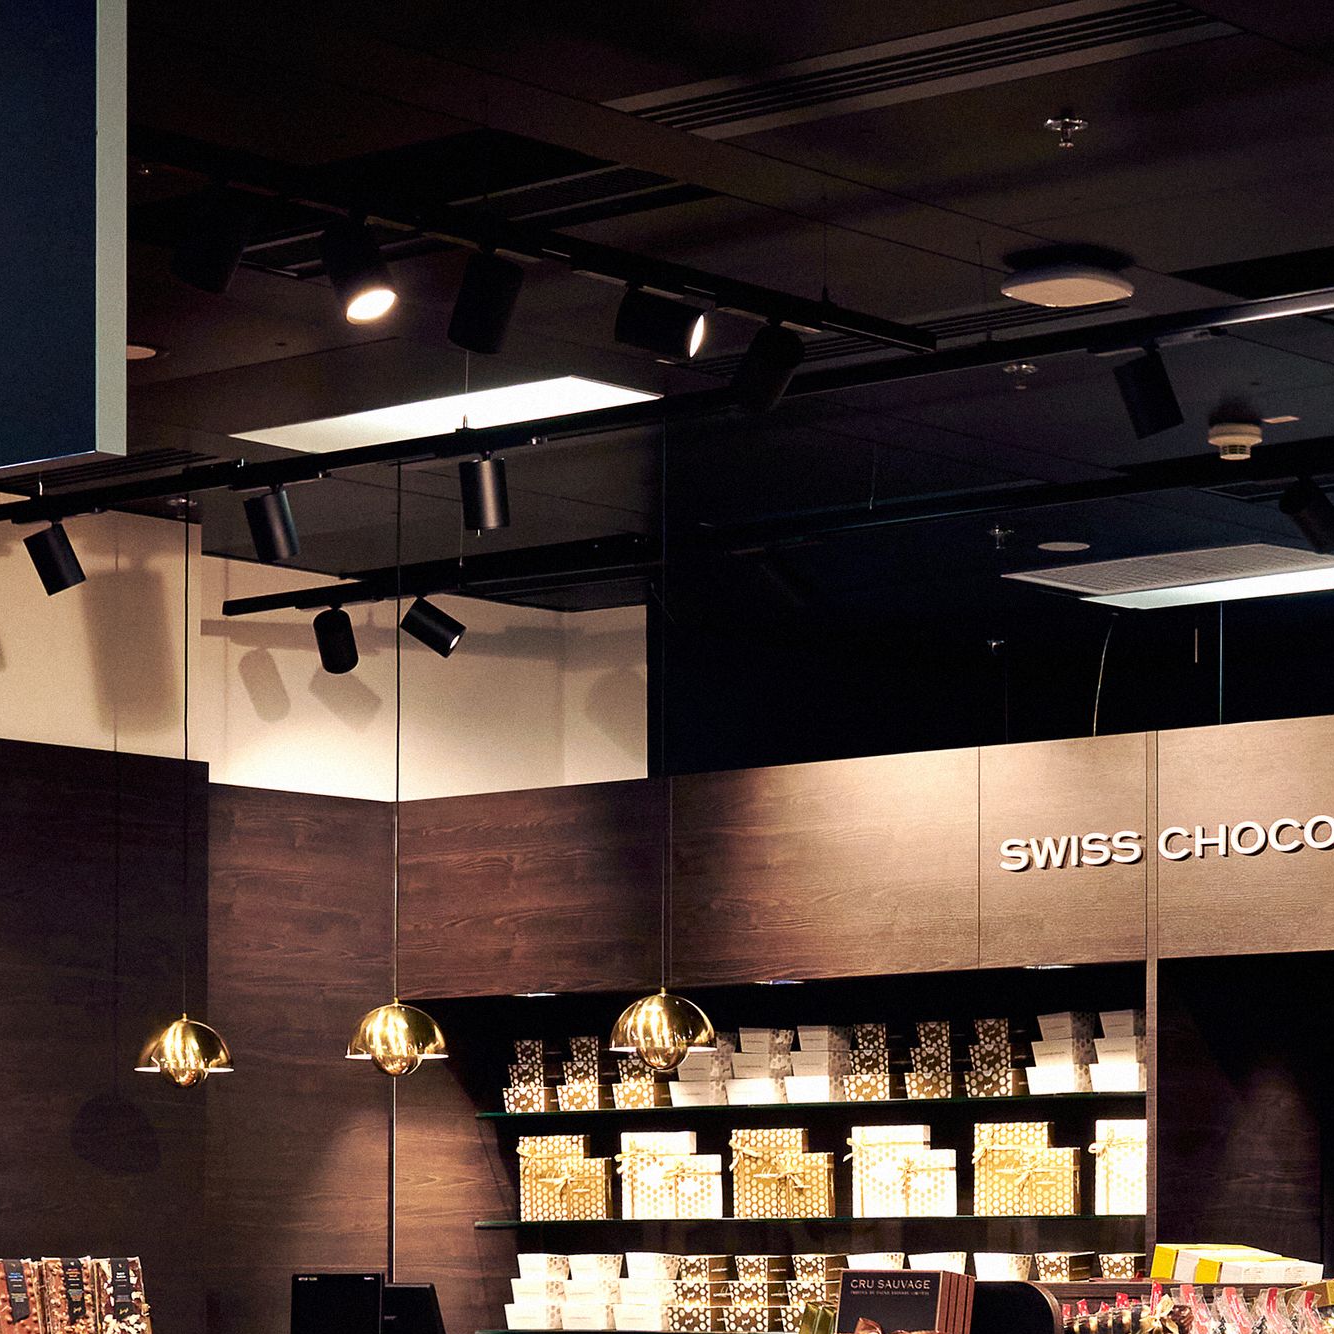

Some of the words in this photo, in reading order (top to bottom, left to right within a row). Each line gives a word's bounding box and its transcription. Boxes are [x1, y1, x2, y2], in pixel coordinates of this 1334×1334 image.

[1000, 829, 1141, 872] SWISS
[850, 1279, 875, 1289] CRU
[877, 1279, 931, 1290] SAUVAGE
